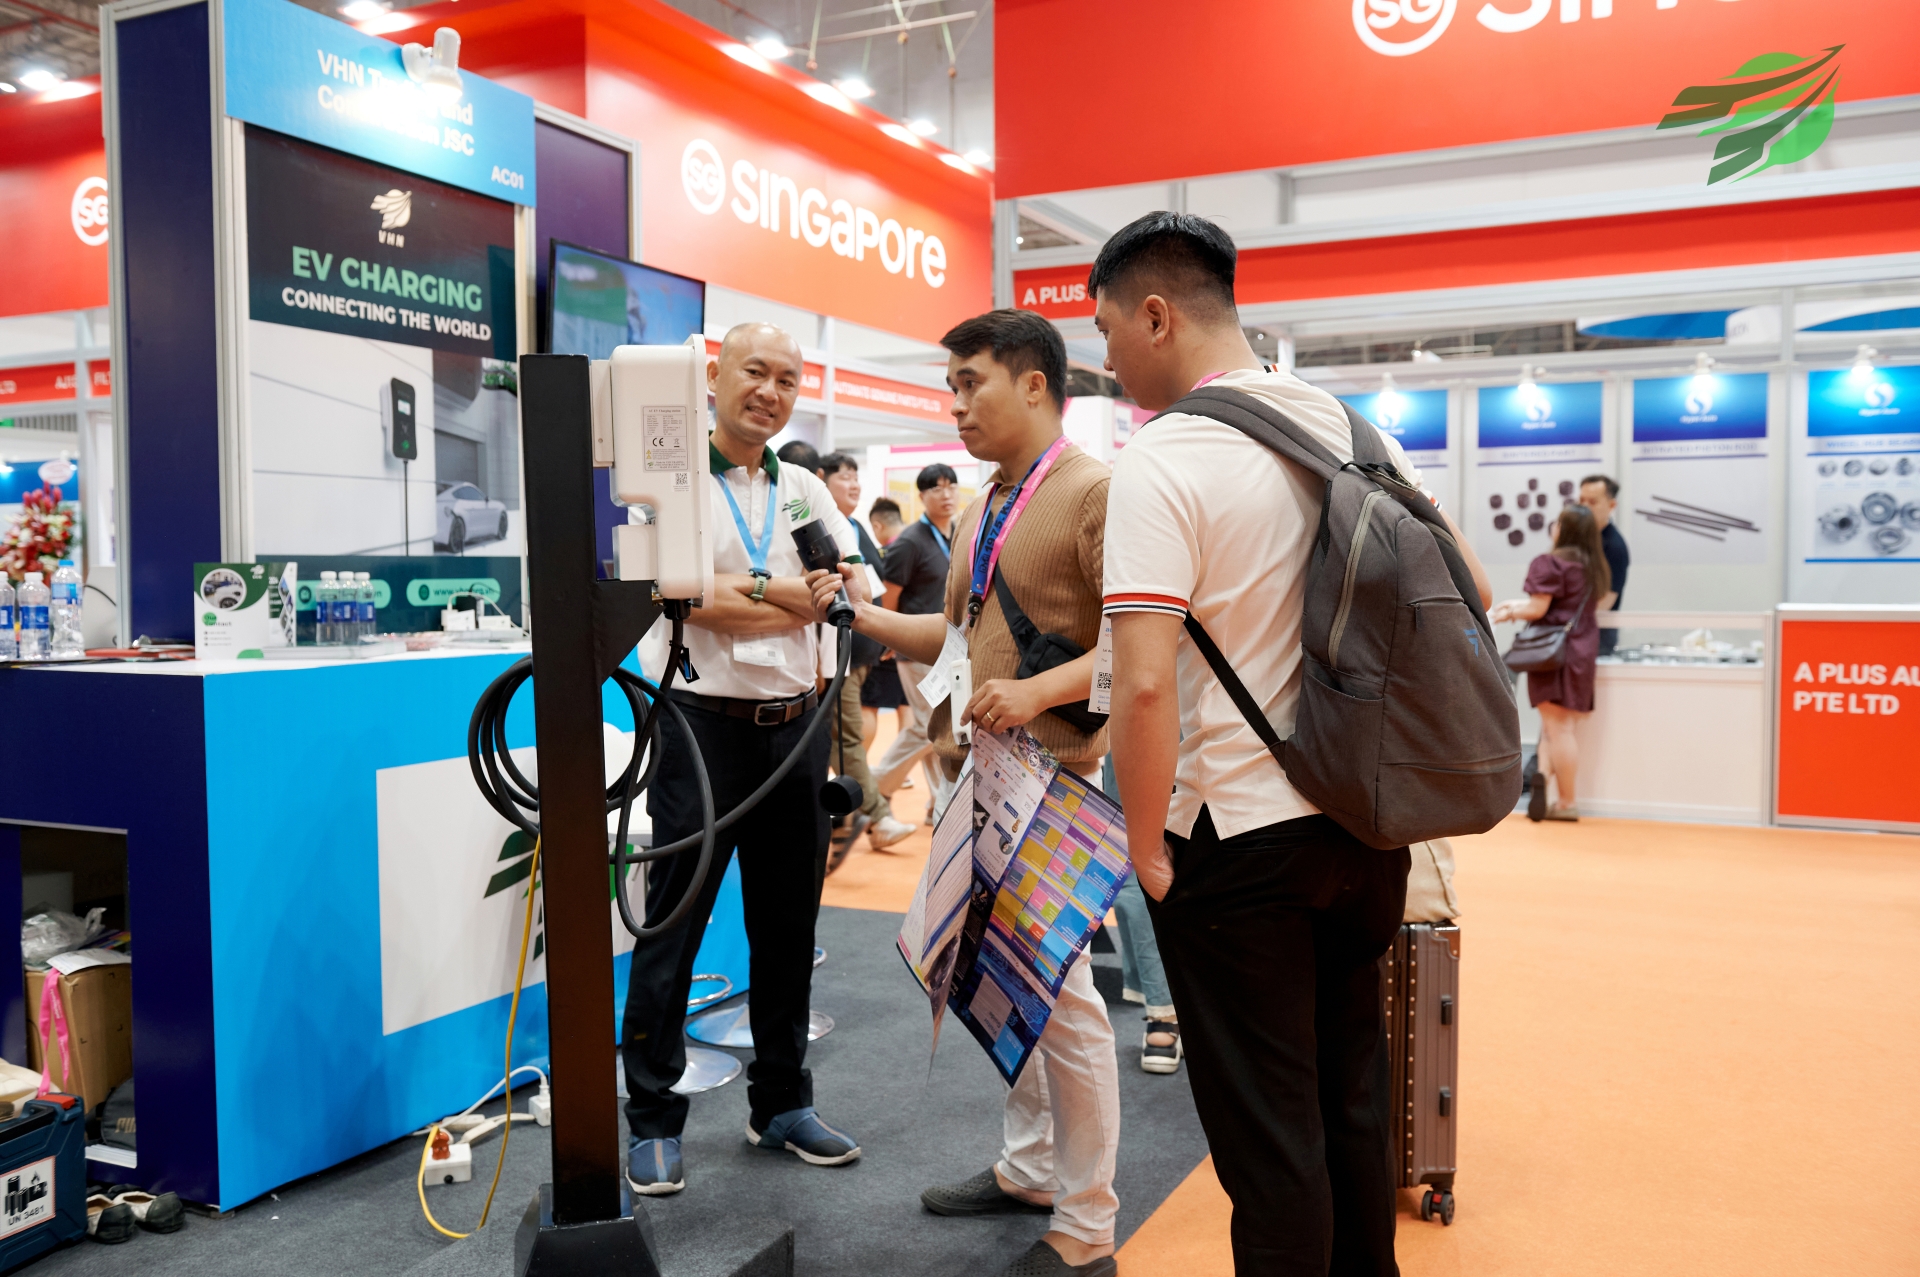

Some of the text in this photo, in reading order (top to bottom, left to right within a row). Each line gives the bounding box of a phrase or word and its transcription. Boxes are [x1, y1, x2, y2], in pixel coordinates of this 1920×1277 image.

[317, 49, 364, 87] VHN
[442, 126, 475, 156] JSC
[491, 165, 525, 190] AC01
[687, 156, 720, 196] SG
[378, 230, 405, 248] VHN
[292, 245, 483, 312] EV CHARGING
[1022, 283, 1086, 306] A PLUS
[281, 287, 492, 341] CONNECTING THE WORLD
[1793, 662, 1814, 683] A
[1818, 662, 1887, 686] PLUS
[1793, 690, 1900, 716] PTE LTD
[8, 1204, 45, 1226] UN 3481
